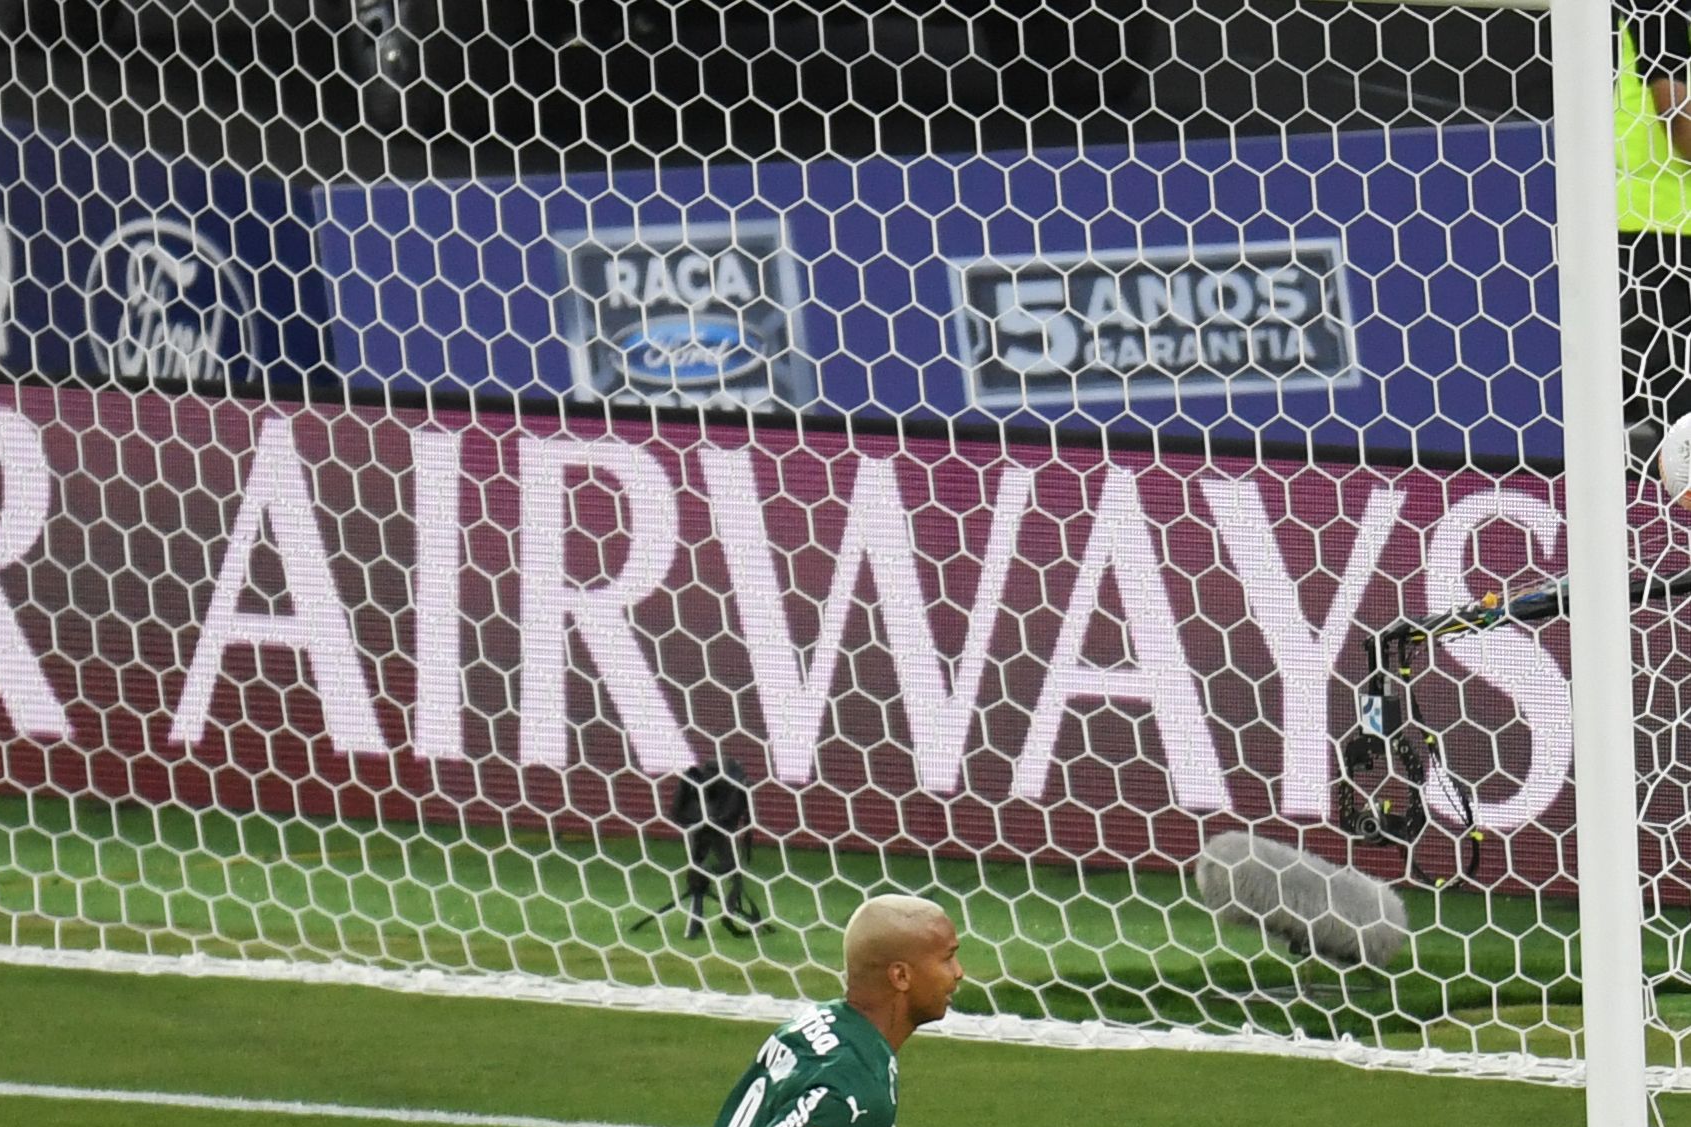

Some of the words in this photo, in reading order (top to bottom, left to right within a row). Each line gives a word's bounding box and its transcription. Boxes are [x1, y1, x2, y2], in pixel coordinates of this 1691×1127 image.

[995, 278, 1079, 374] 5
[1082, 266, 1309, 331] ANOS
[1082, 327, 1316, 366] GARANTIA
[167, 417, 1575, 830] AIRWAYS
